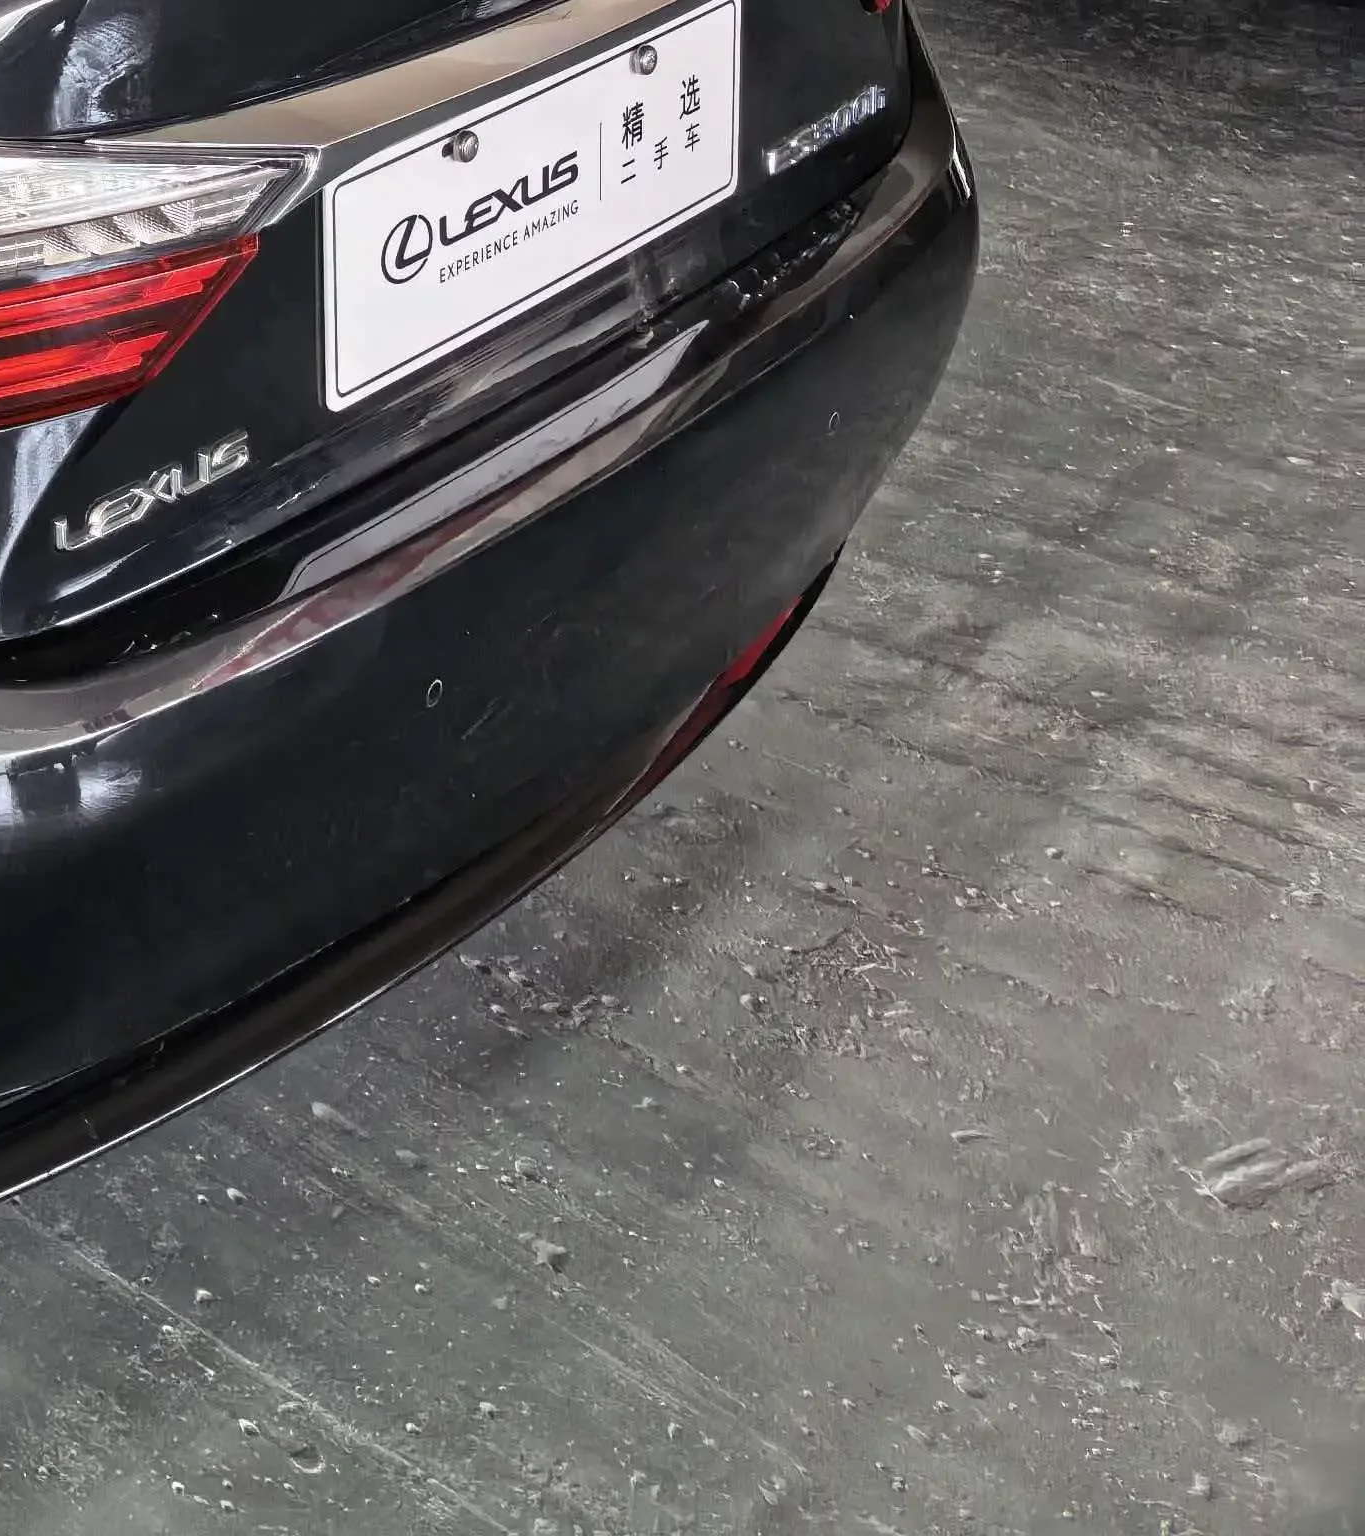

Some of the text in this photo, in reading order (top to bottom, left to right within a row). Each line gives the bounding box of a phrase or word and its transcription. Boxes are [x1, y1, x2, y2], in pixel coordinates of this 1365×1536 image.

[438, 150, 580, 247] LEXUS
[619, 122, 702, 186] 二手车
[438, 199, 580, 284] EXPERIENCE AMAZING
[52, 429, 249, 551] LEXUS
